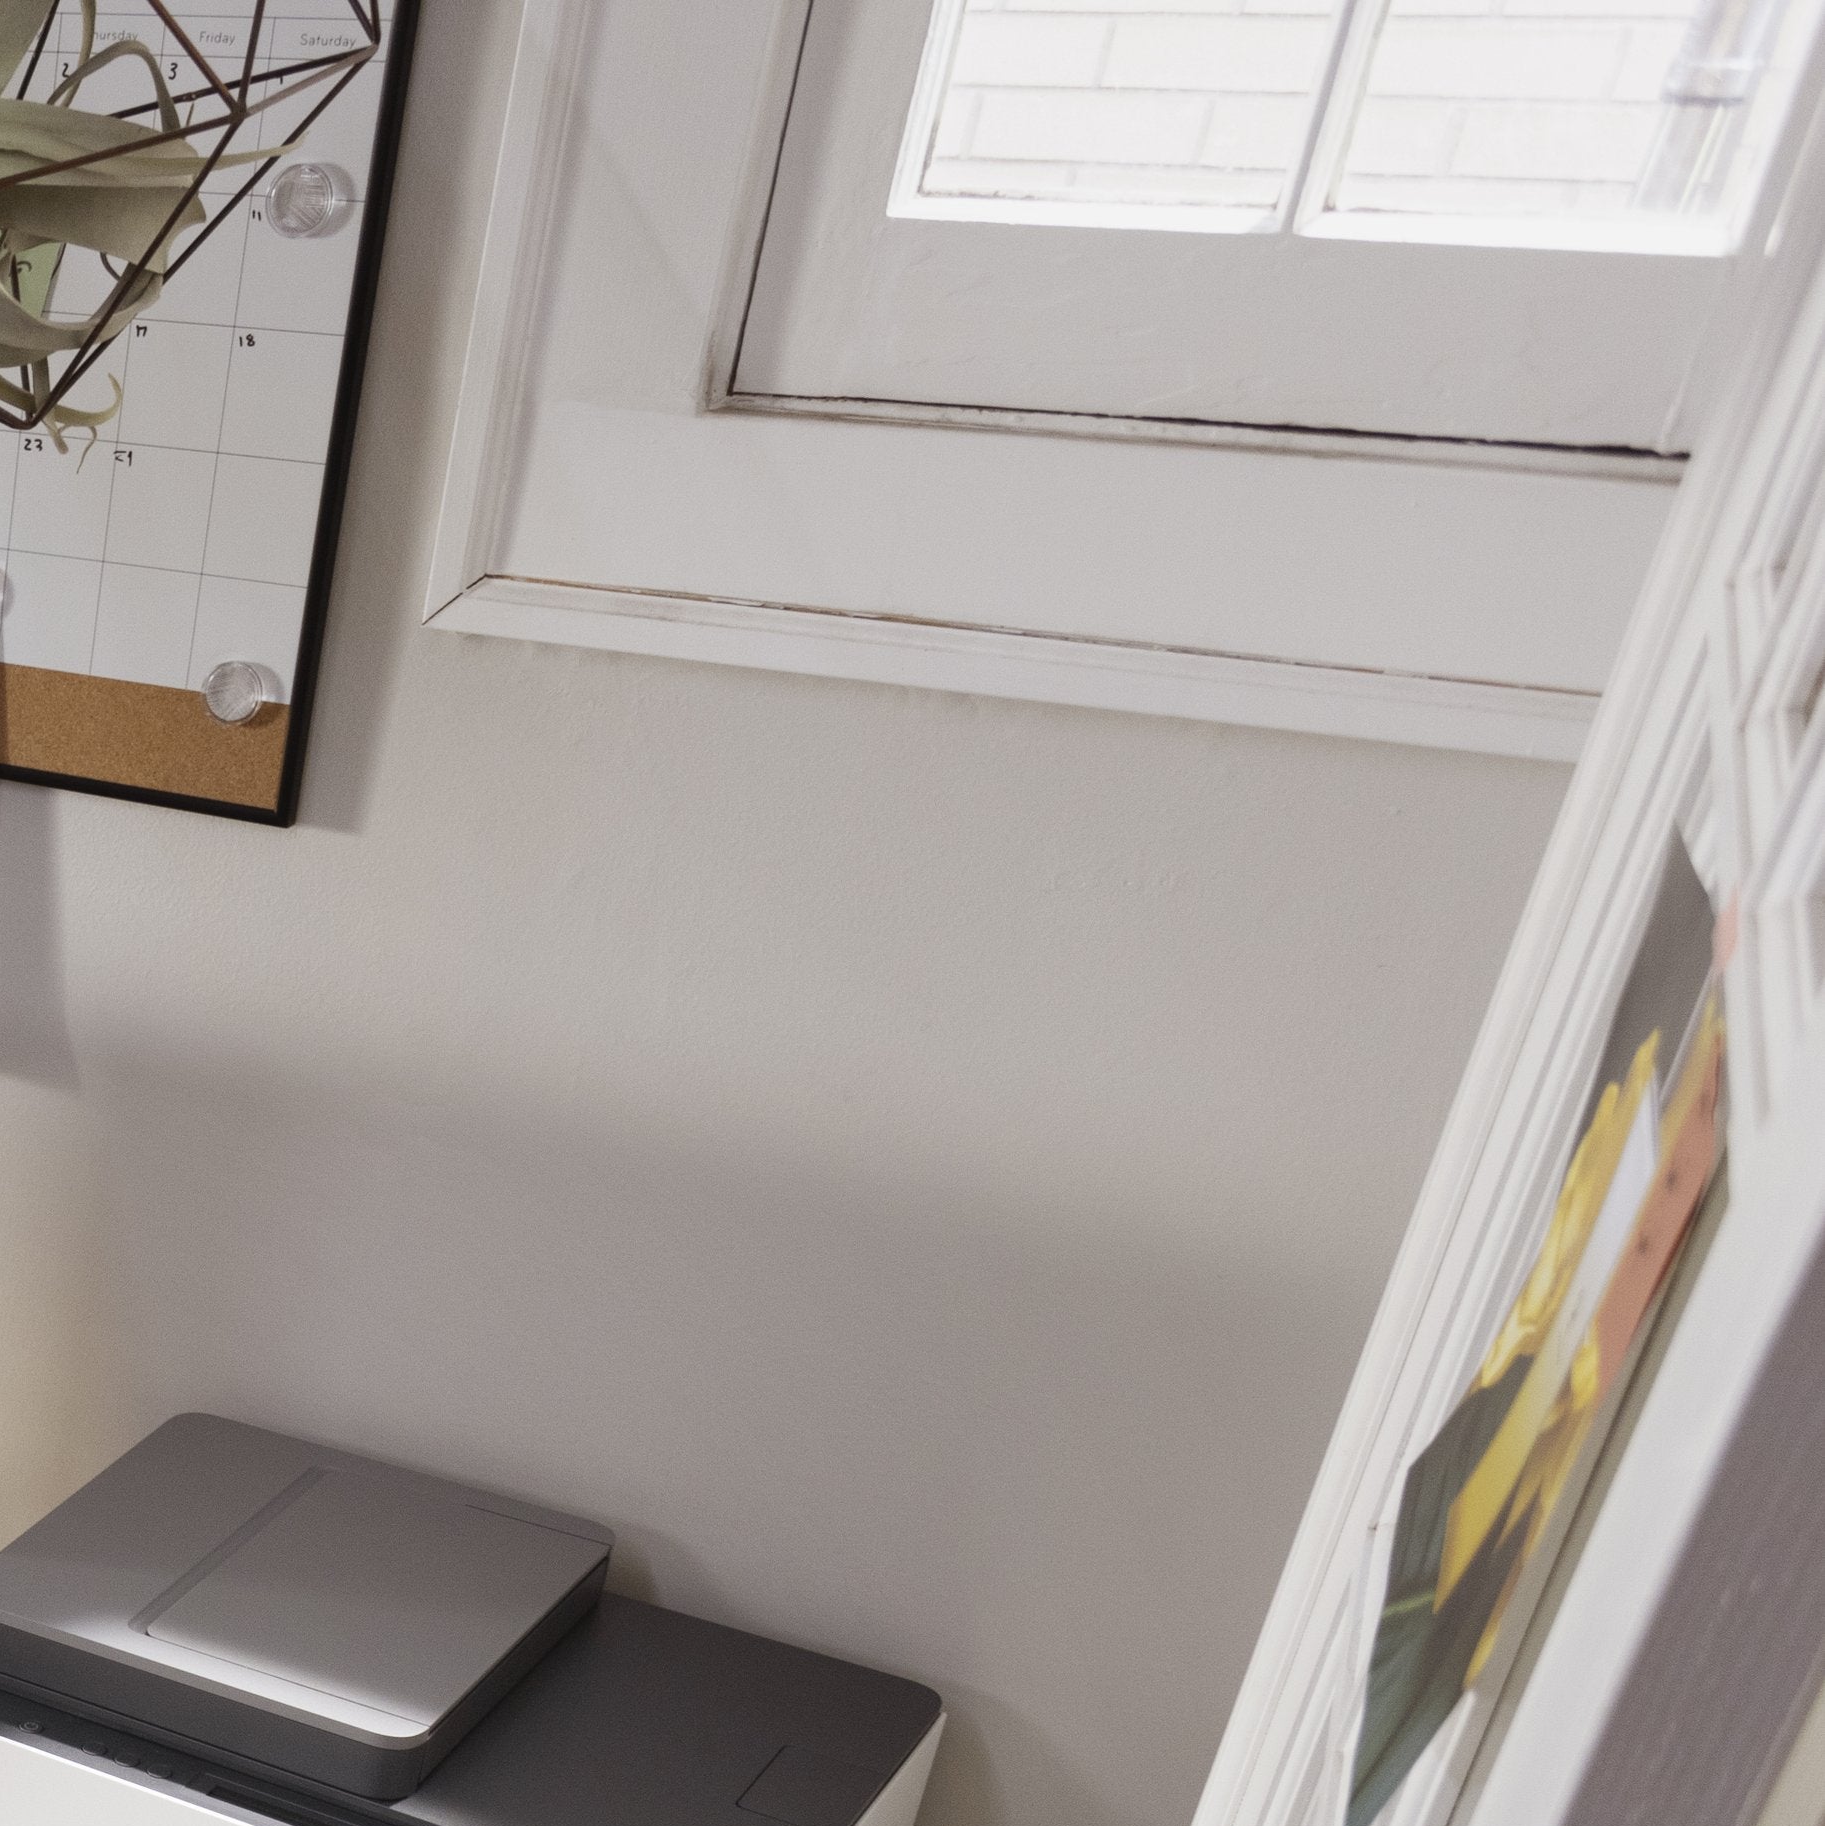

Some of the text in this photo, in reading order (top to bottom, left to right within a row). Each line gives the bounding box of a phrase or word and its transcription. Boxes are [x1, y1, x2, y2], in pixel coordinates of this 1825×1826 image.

[92, 31, 138, 41] hursday
[199, 31, 236, 45] Friday
[300, 33, 357, 48] Saturday
[168, 62, 178, 80] 3
[252, 210, 261, 221] 11
[238, 335, 256, 347] 18
[23, 438, 43, 452] 23
